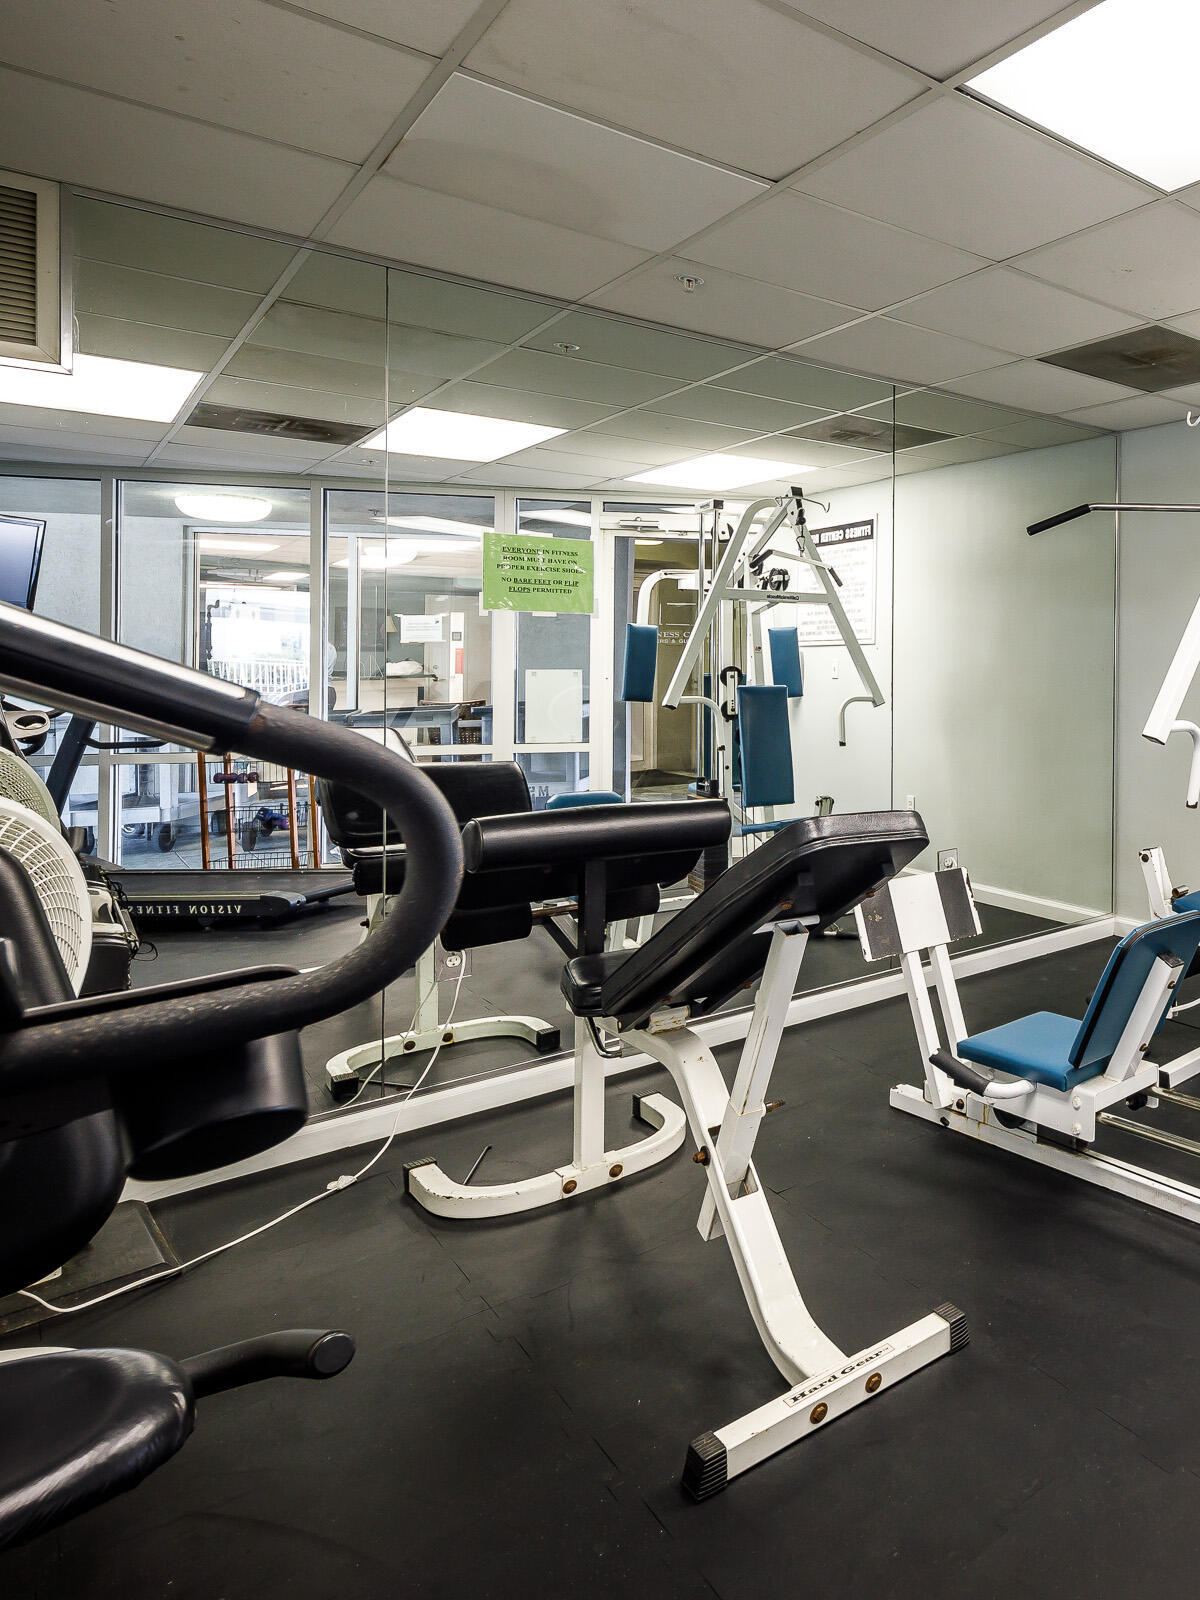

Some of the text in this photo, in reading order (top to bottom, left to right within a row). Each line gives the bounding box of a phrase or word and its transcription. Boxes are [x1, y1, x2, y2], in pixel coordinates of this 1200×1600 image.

[534, 578, 552, 586] FEET
[532, 587, 573, 595] PERMITTED
[791, 1374, 839, 1403] Hard
